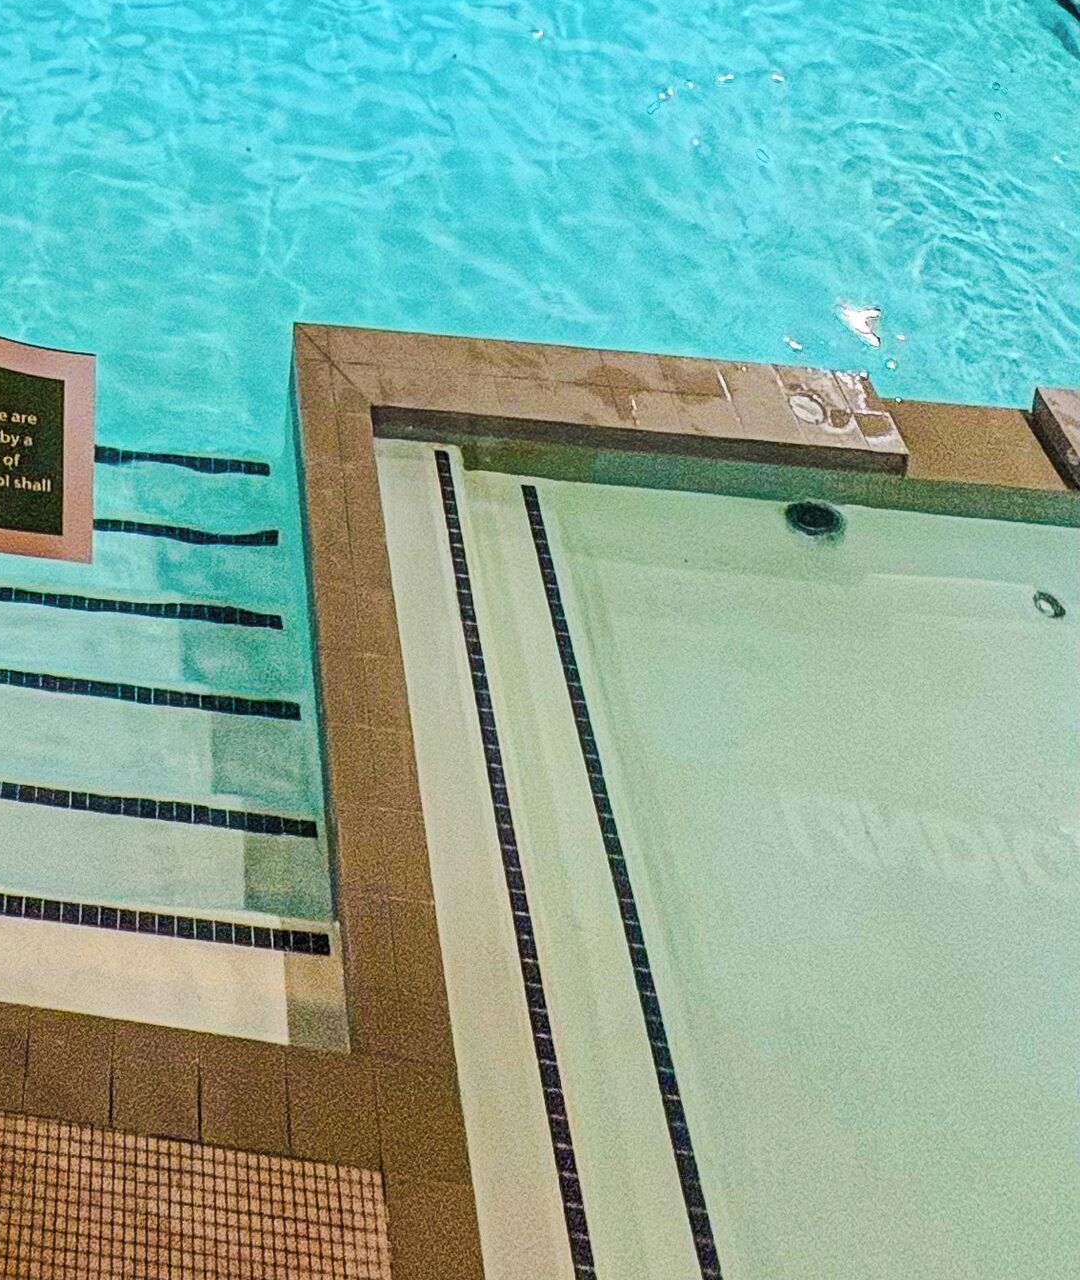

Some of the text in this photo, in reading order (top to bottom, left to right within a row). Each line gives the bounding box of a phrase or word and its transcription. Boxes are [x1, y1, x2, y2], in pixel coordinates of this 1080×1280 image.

[11, 412, 37, 425] are
[0, 430, 20, 447] by
[23, 436, 33, 446] a
[3, 453, 21, 467] of
[14, 476, 52, 492] shall
